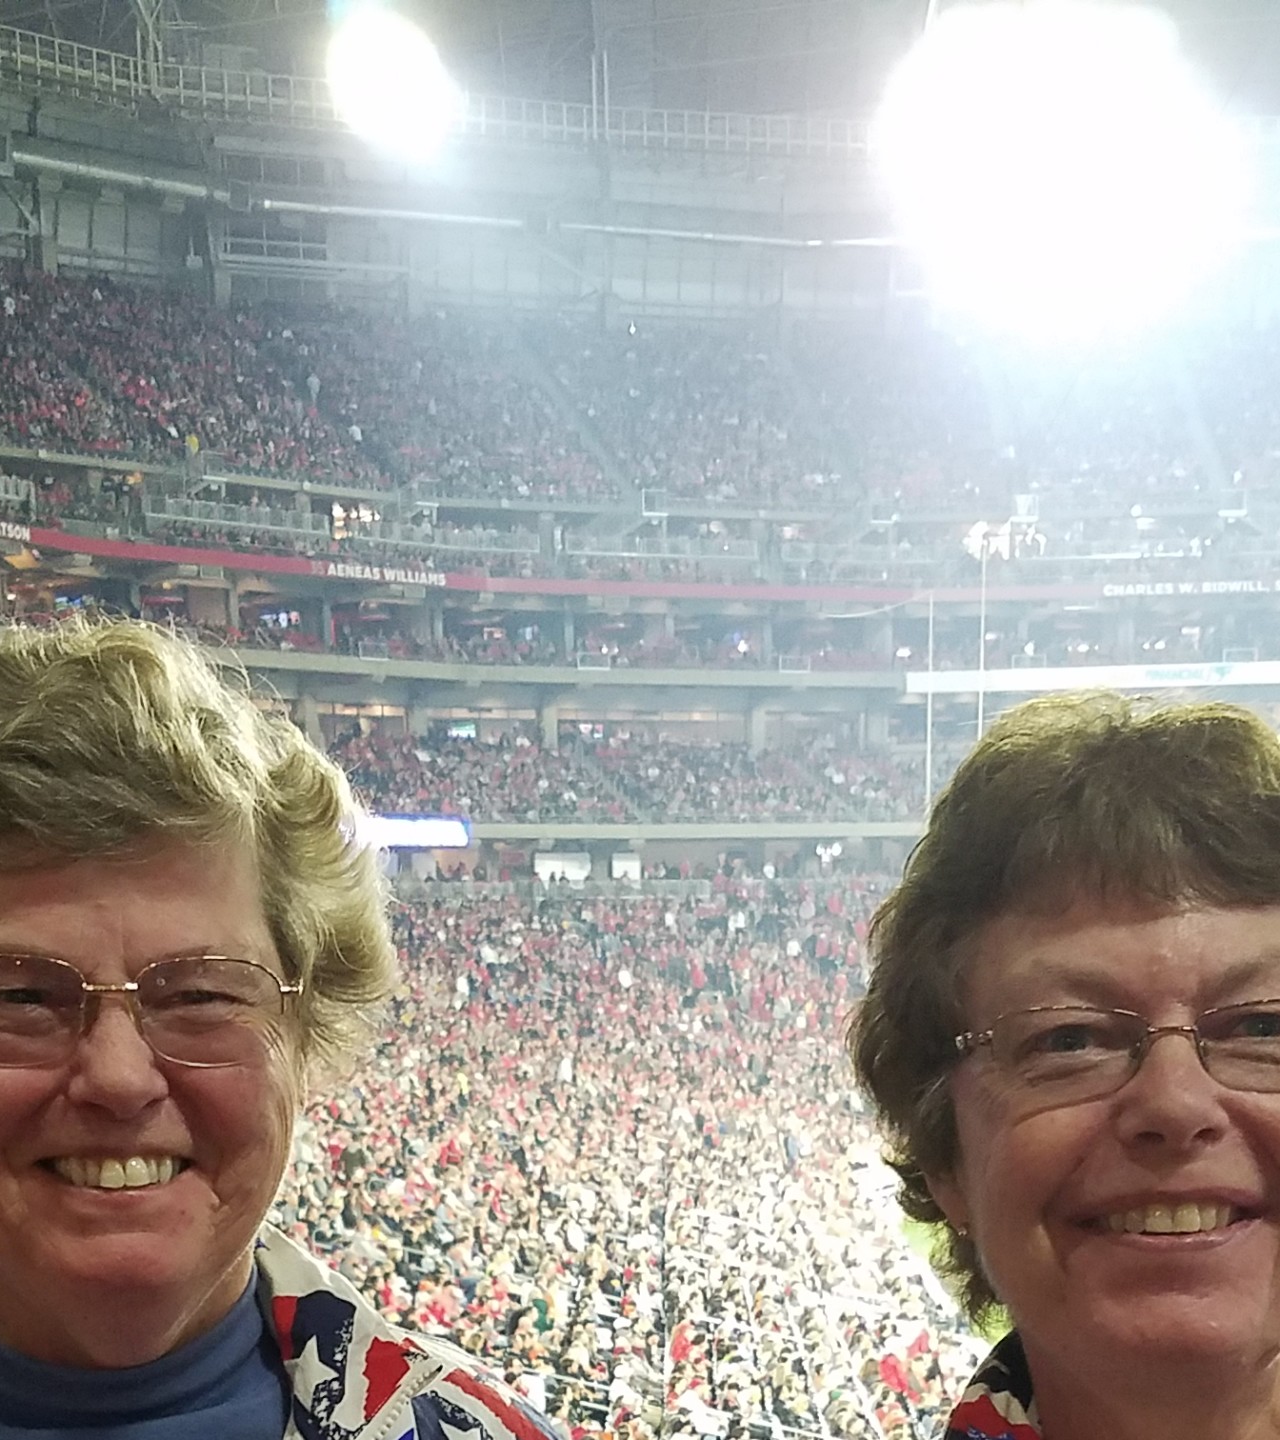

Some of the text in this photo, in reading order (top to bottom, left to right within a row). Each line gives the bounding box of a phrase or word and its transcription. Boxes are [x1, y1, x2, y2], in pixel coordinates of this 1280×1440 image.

[327, 563, 380, 580] AENEAS
[383, 567, 446, 586] WILLIAMS
[1103, 583, 1173, 596] CHARLES
[1178, 583, 1198, 594] W.
